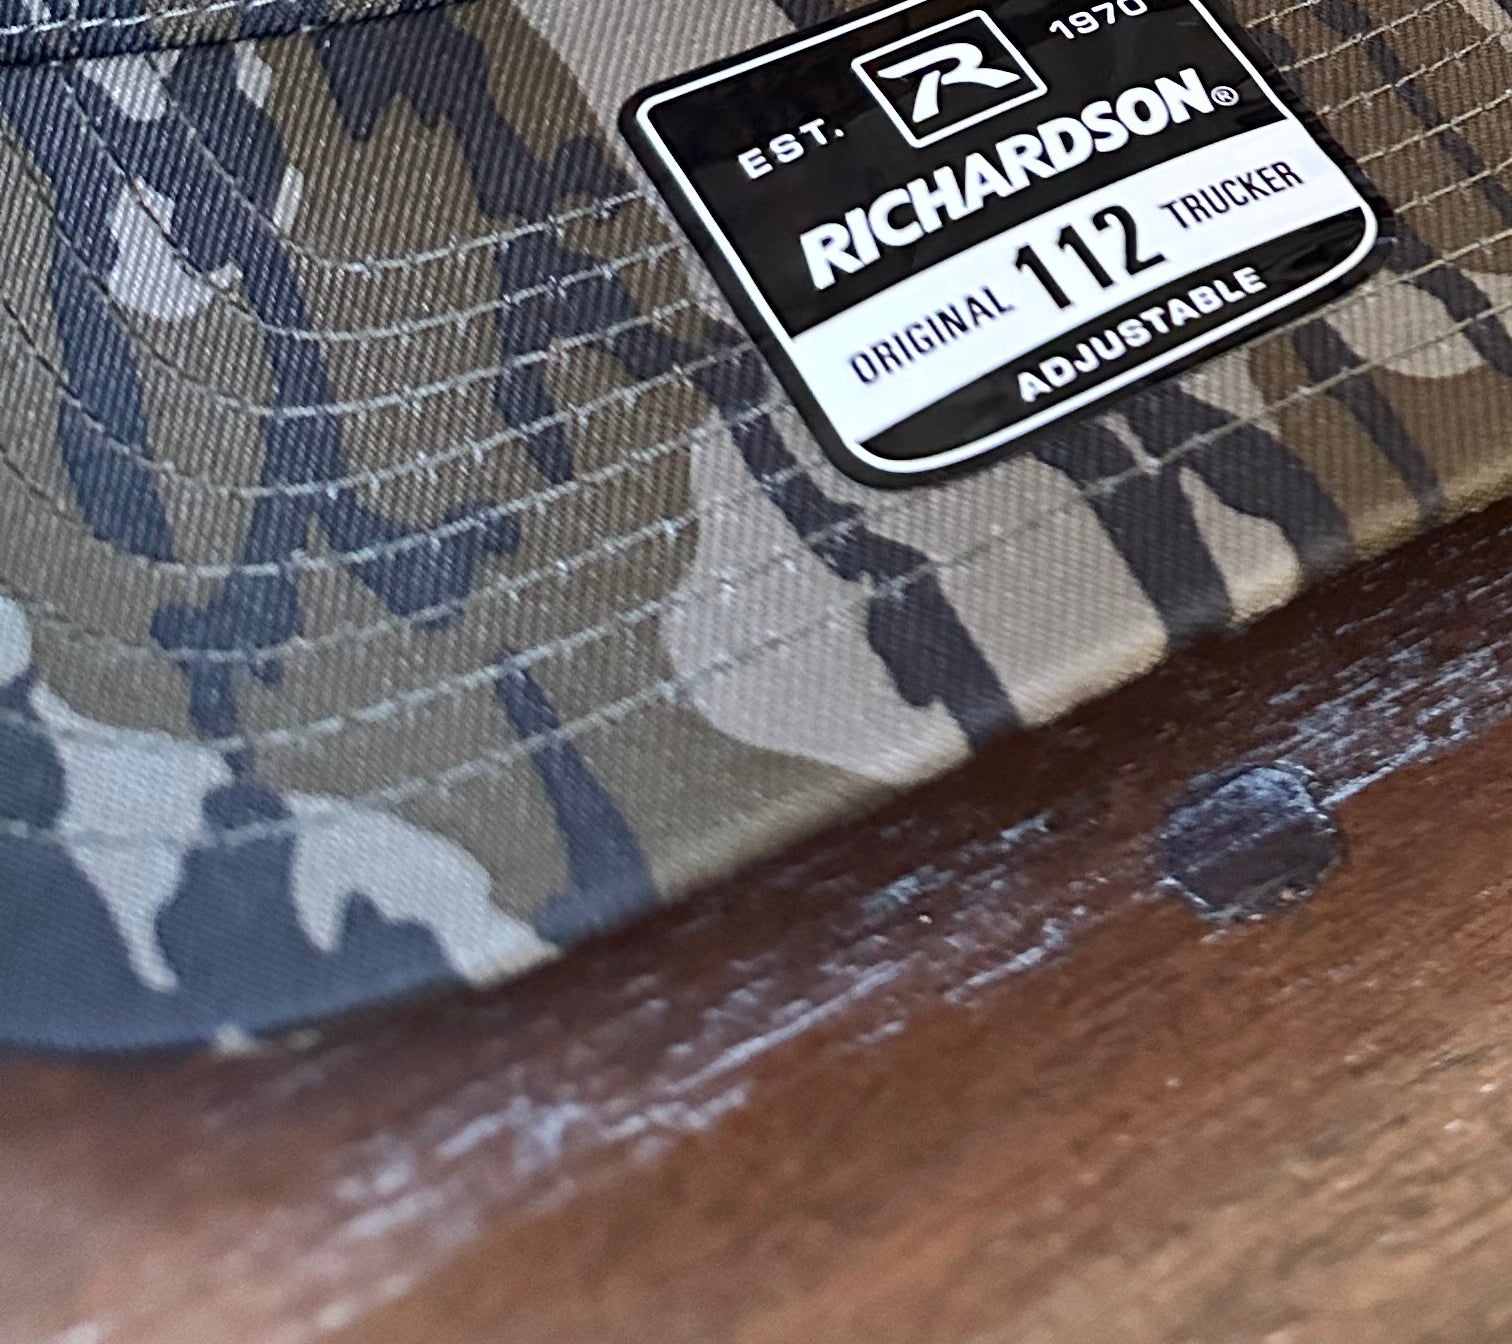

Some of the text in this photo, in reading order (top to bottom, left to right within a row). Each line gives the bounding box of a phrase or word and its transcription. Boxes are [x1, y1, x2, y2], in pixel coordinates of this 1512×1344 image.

[737, 117, 845, 180] EST.
[847, 160, 1305, 387] ORIGINAL 112 TRUCKER
[1016, 265, 1267, 404] ADJUSTABLE
